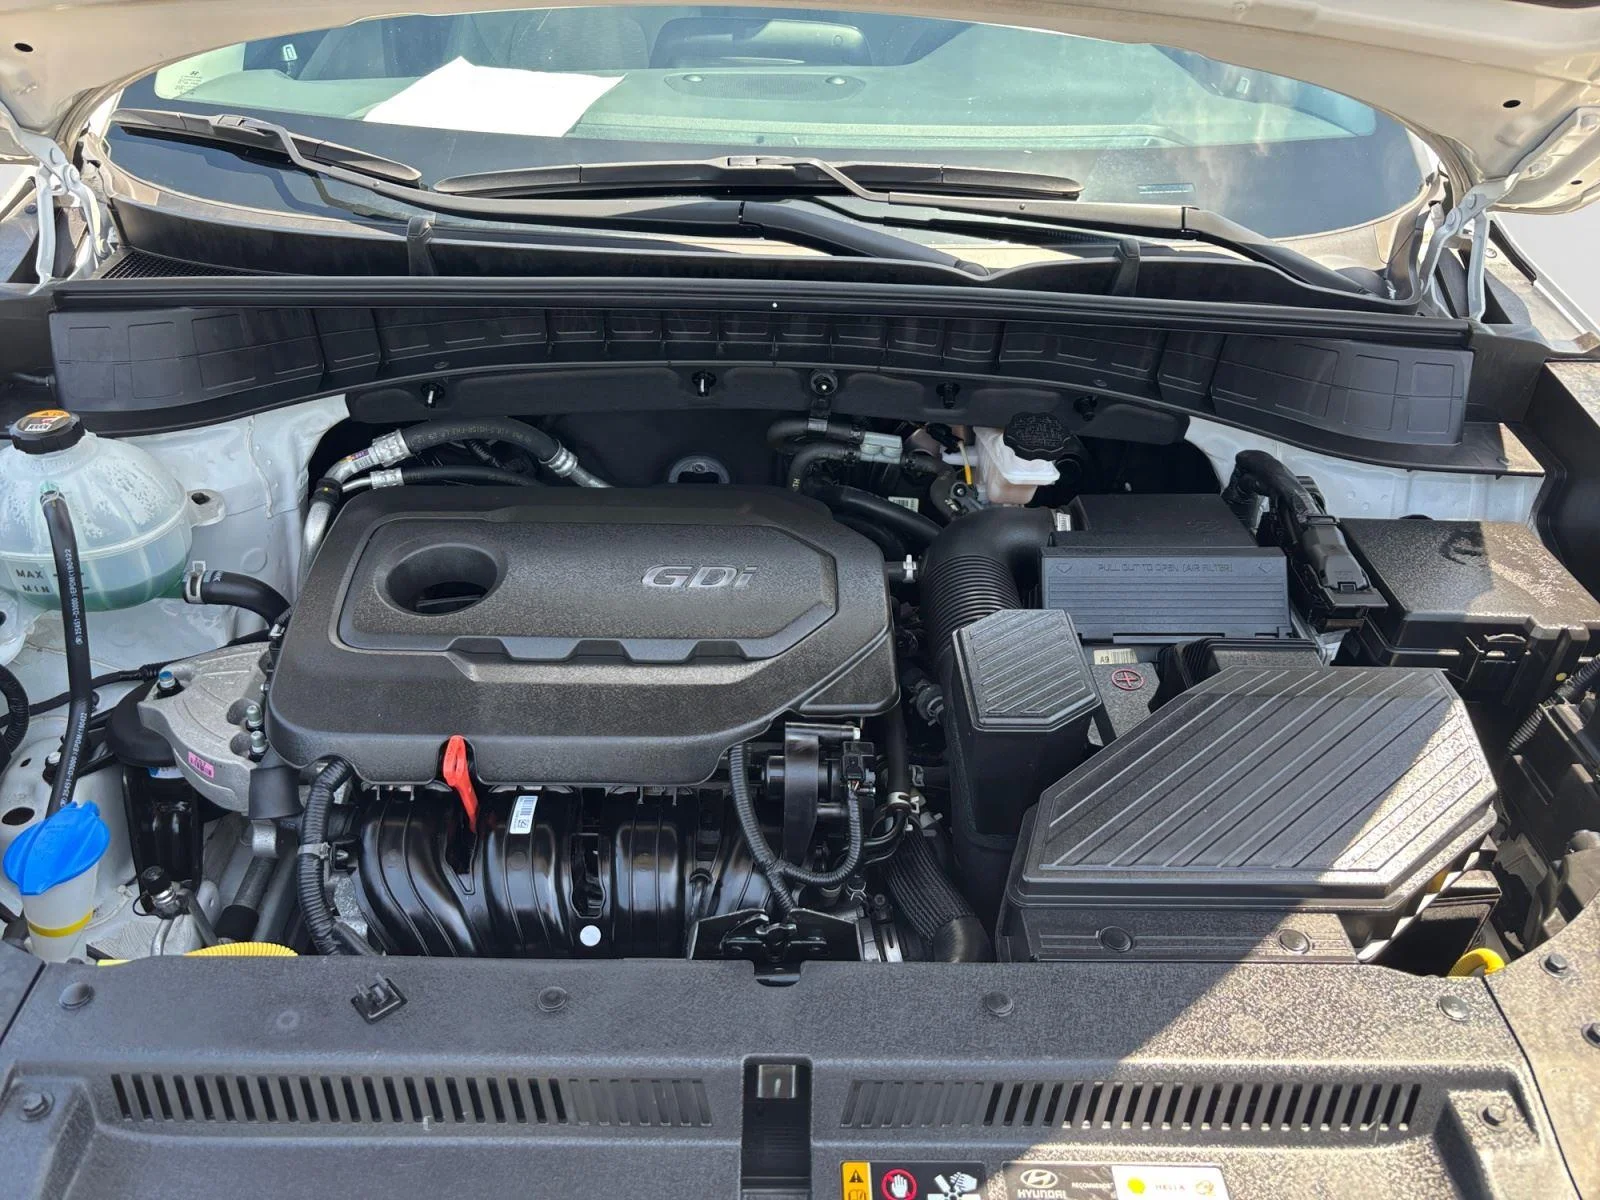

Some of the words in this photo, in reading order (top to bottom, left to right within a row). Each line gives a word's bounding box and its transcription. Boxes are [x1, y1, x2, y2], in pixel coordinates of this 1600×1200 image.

[15, 568, 44, 579] MAX
[640, 563, 758, 588] GDi
[21, 584, 50, 593] MIN
[1017, 1188, 1067, 1199] HYUNDAI
